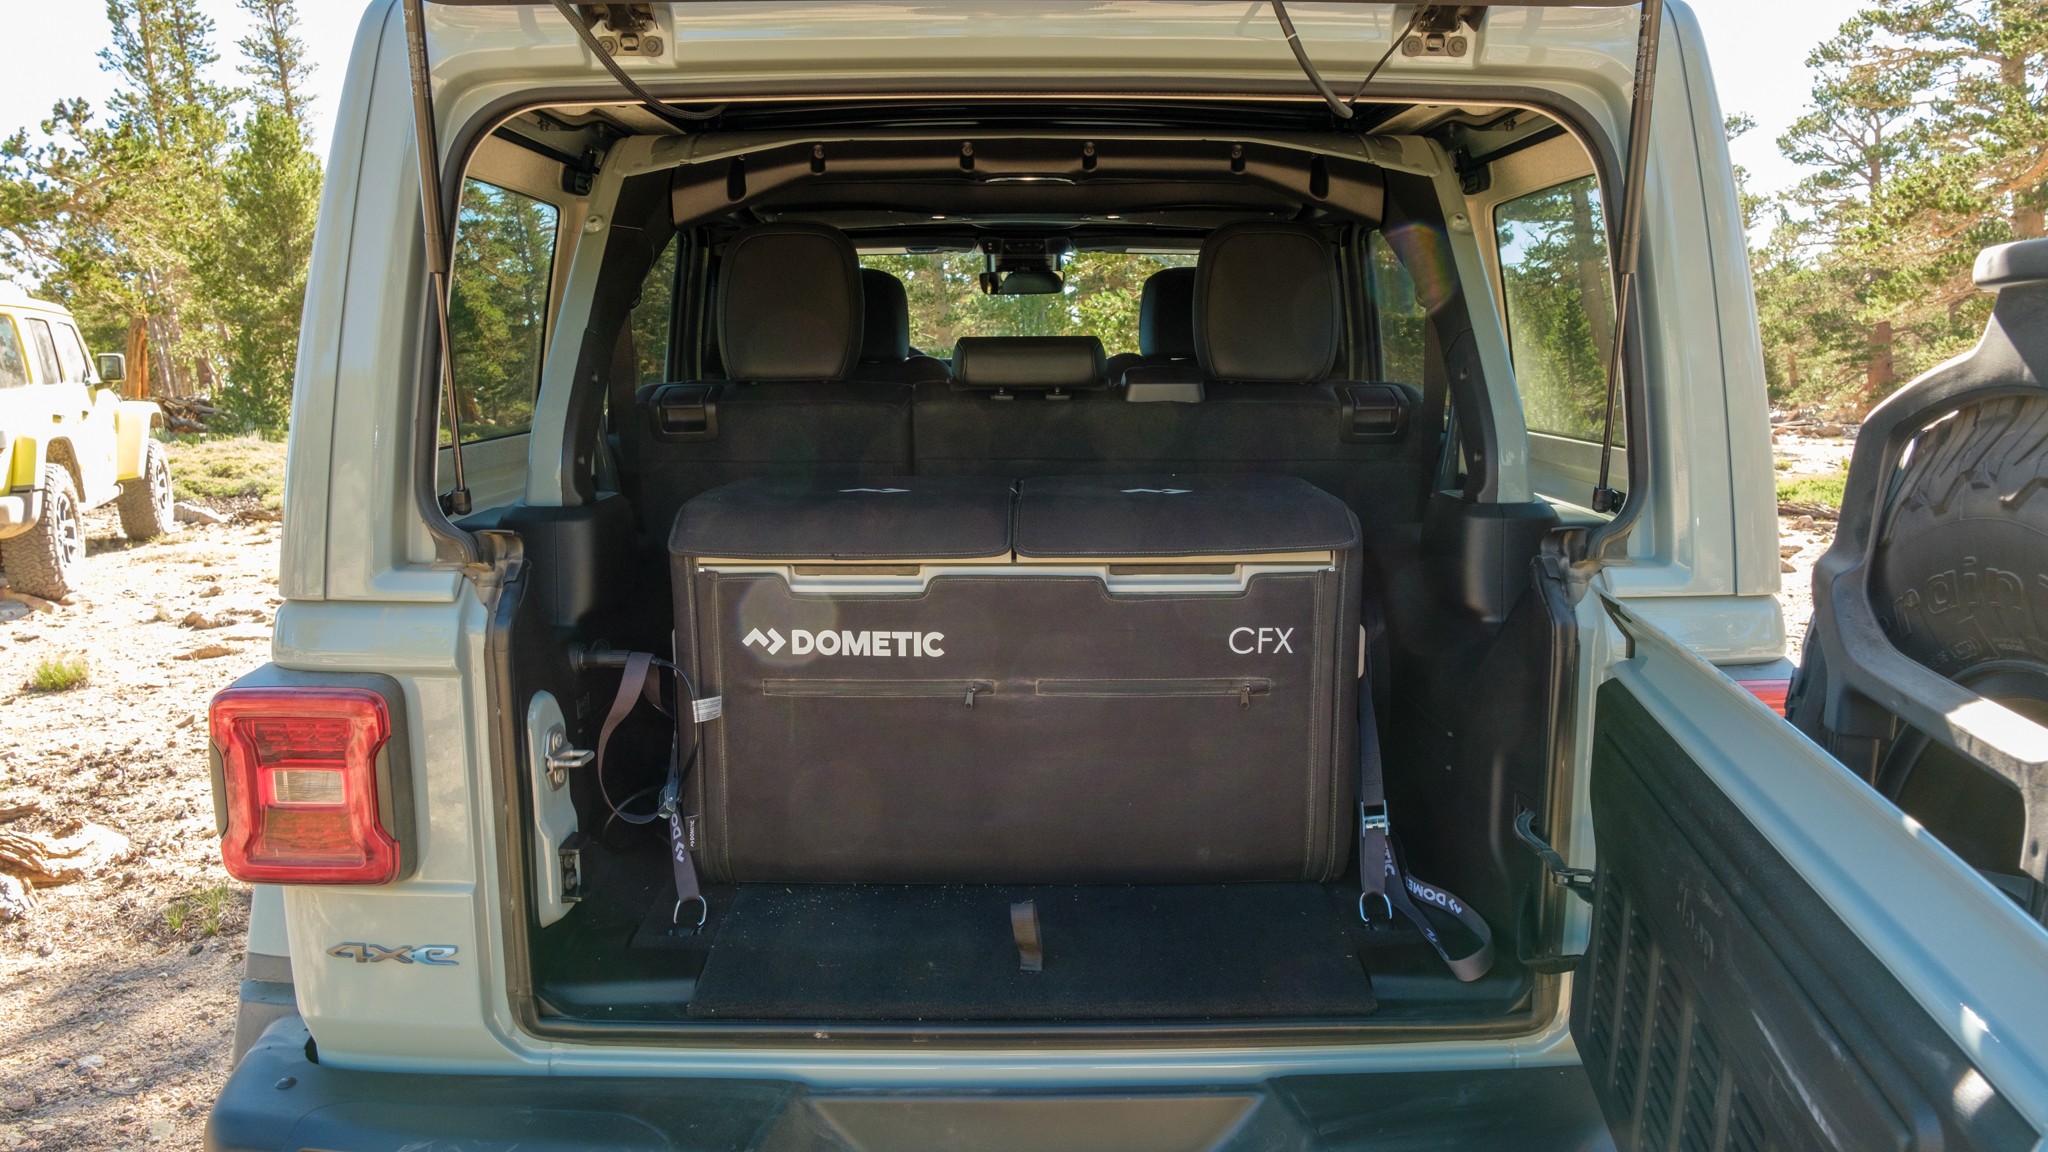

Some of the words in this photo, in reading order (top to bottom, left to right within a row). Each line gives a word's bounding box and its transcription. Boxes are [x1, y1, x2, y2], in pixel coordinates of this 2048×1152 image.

[791, 629, 945, 658] DOMETIC
[1228, 626, 1295, 655] CFX
[1384, 841, 1396, 877] TIC
[1406, 876, 1447, 907] DOME
